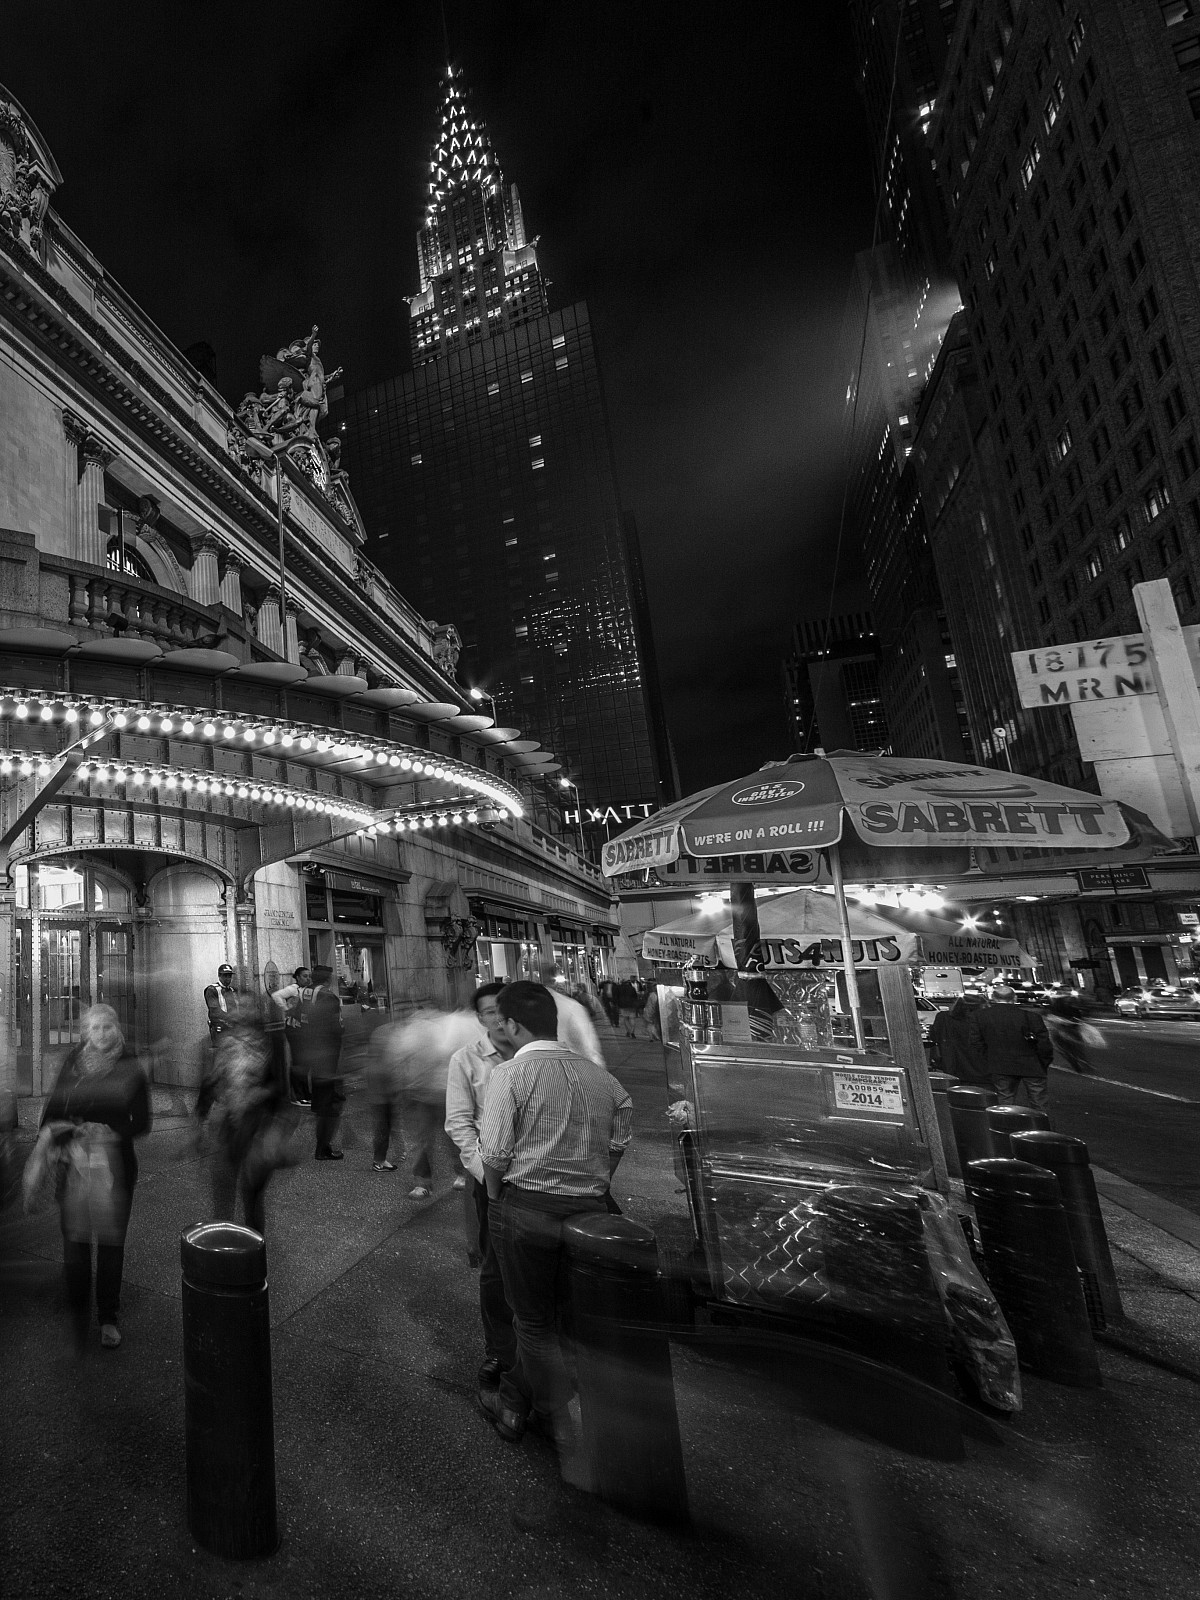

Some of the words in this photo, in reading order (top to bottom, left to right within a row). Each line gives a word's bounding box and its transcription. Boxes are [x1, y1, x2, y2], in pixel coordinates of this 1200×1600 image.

[737, 791, 794, 803] INSPECTED
[565, 803, 653, 825] HYATT
[860, 801, 1105, 835] SABRETT
[694, 832, 732, 846] WE'RE
[735, 829, 752, 841] ON
[756, 828, 765, 838] A
[769, 823, 803, 837] ROLL
[605, 826, 675, 867] SABRETT
[660, 936, 670, 946] ALL
[670, 937, 696, 949] NATURAL
[950, 937, 964, 947] ALL
[966, 938, 1000, 949] NATURAL
[929, 951, 998, 965] HONEY-ROASTED
[1000, 954, 1021, 966] NUTS
[840, 1083, 884, 1092] TA00859
[851, 1092, 883, 1105] 2014
